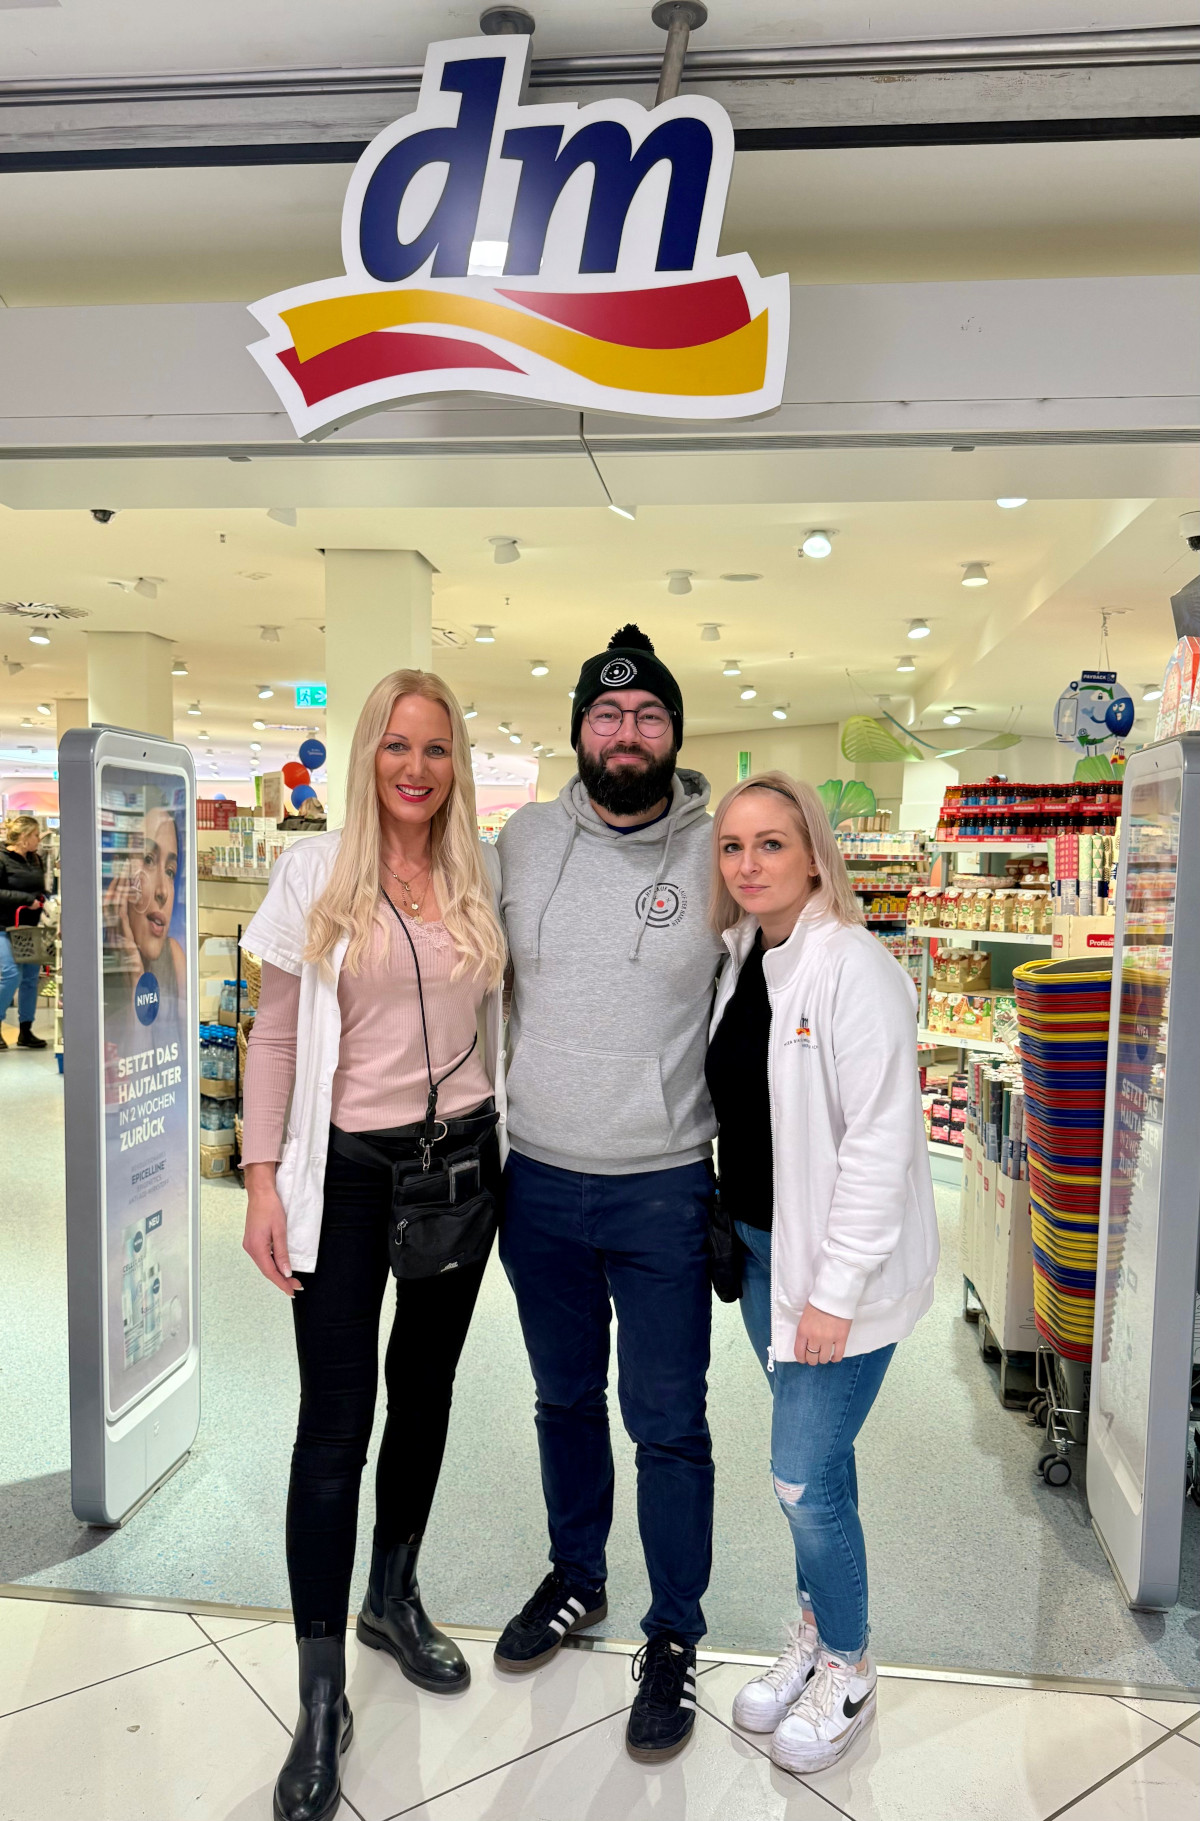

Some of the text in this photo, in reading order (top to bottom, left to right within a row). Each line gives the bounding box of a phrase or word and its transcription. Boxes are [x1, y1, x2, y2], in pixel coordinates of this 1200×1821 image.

[359, 56, 713, 283] dm
[137, 992, 158, 1006] NIVEA
[118, 1042, 179, 1078] SETZT DAS
[118, 1065, 182, 1104] HAUTALTER
[1121, 1078, 1159, 1120] SETZT DAS
[119, 1091, 176, 1126] IN 2 WOCHEN
[119, 1115, 165, 1151] ZURÜCK
[148, 1214, 160, 1229] NEU
